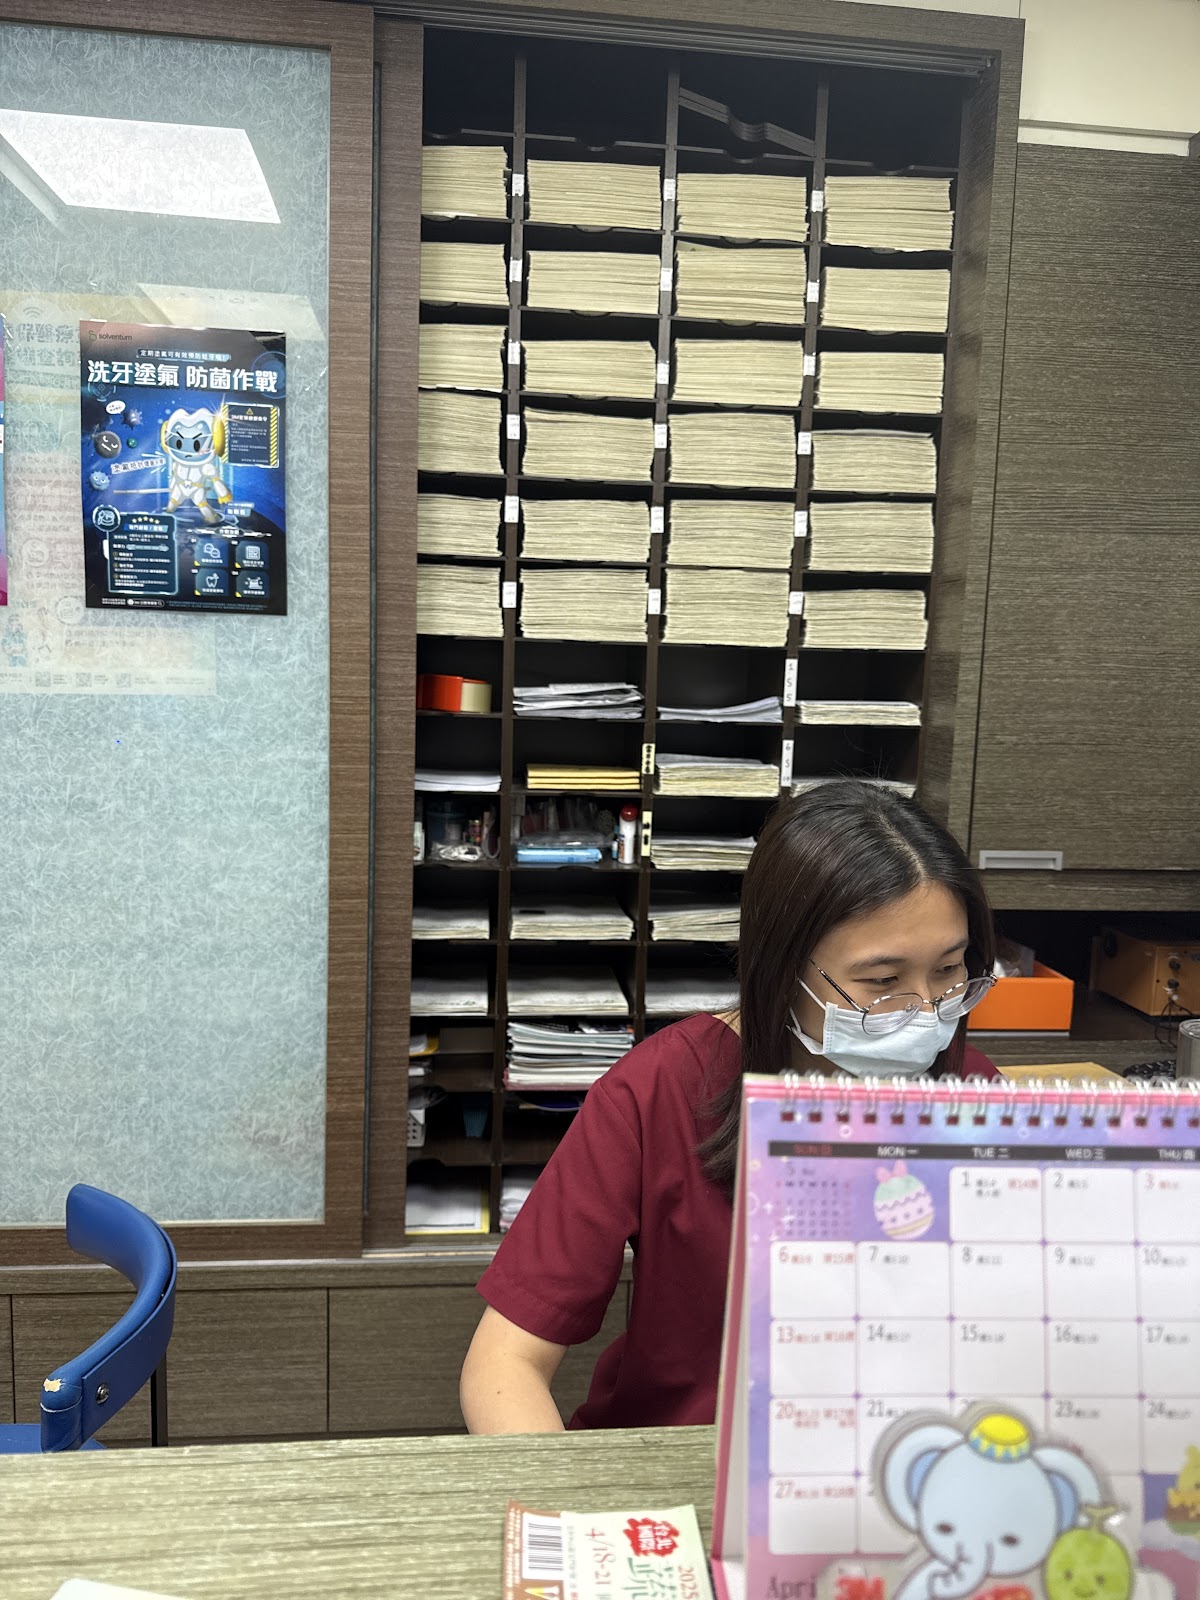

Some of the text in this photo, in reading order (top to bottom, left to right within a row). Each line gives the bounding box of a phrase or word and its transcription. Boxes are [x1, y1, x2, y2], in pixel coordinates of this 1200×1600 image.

[98, 333, 133, 341] solventum
[87, 360, 180, 388] 洗牙塗氟
[186, 365, 278, 393] 防菌作戰
[877, 1146, 906, 1157] MON
[972, 1147, 996, 1158] TUE
[1065, 1148, 1093, 1159] WED
[1158, 1149, 1181, 1159] THU
[961, 1171, 971, 1187] 1
[1053, 1171, 1064, 1188] 2
[1145, 1172, 1155, 1189] 3
[778, 1246, 789, 1263] 6
[869, 1245, 879, 1262] 7
[962, 1246, 973, 1264] 8
[1054, 1247, 1065, 1264] 9
[1143, 1248, 1162, 1265] 10
[777, 1325, 794, 1343] 13
[866, 1323, 885, 1341] 14
[961, 1323, 979, 1342] 15
[1055, 1325, 1072, 1343] 16
[1146, 1325, 1165, 1343] 17
[775, 1401, 794, 1419] 20
[866, 1400, 885, 1418] 21
[1055, 1400, 1074, 1418] 23
[1147, 1400, 1167, 1418] 24
[775, 1480, 795, 1498] 27
[653, 1523, 673, 1551] 台北
[585, 1527, 617, 1585] 4/18-21
